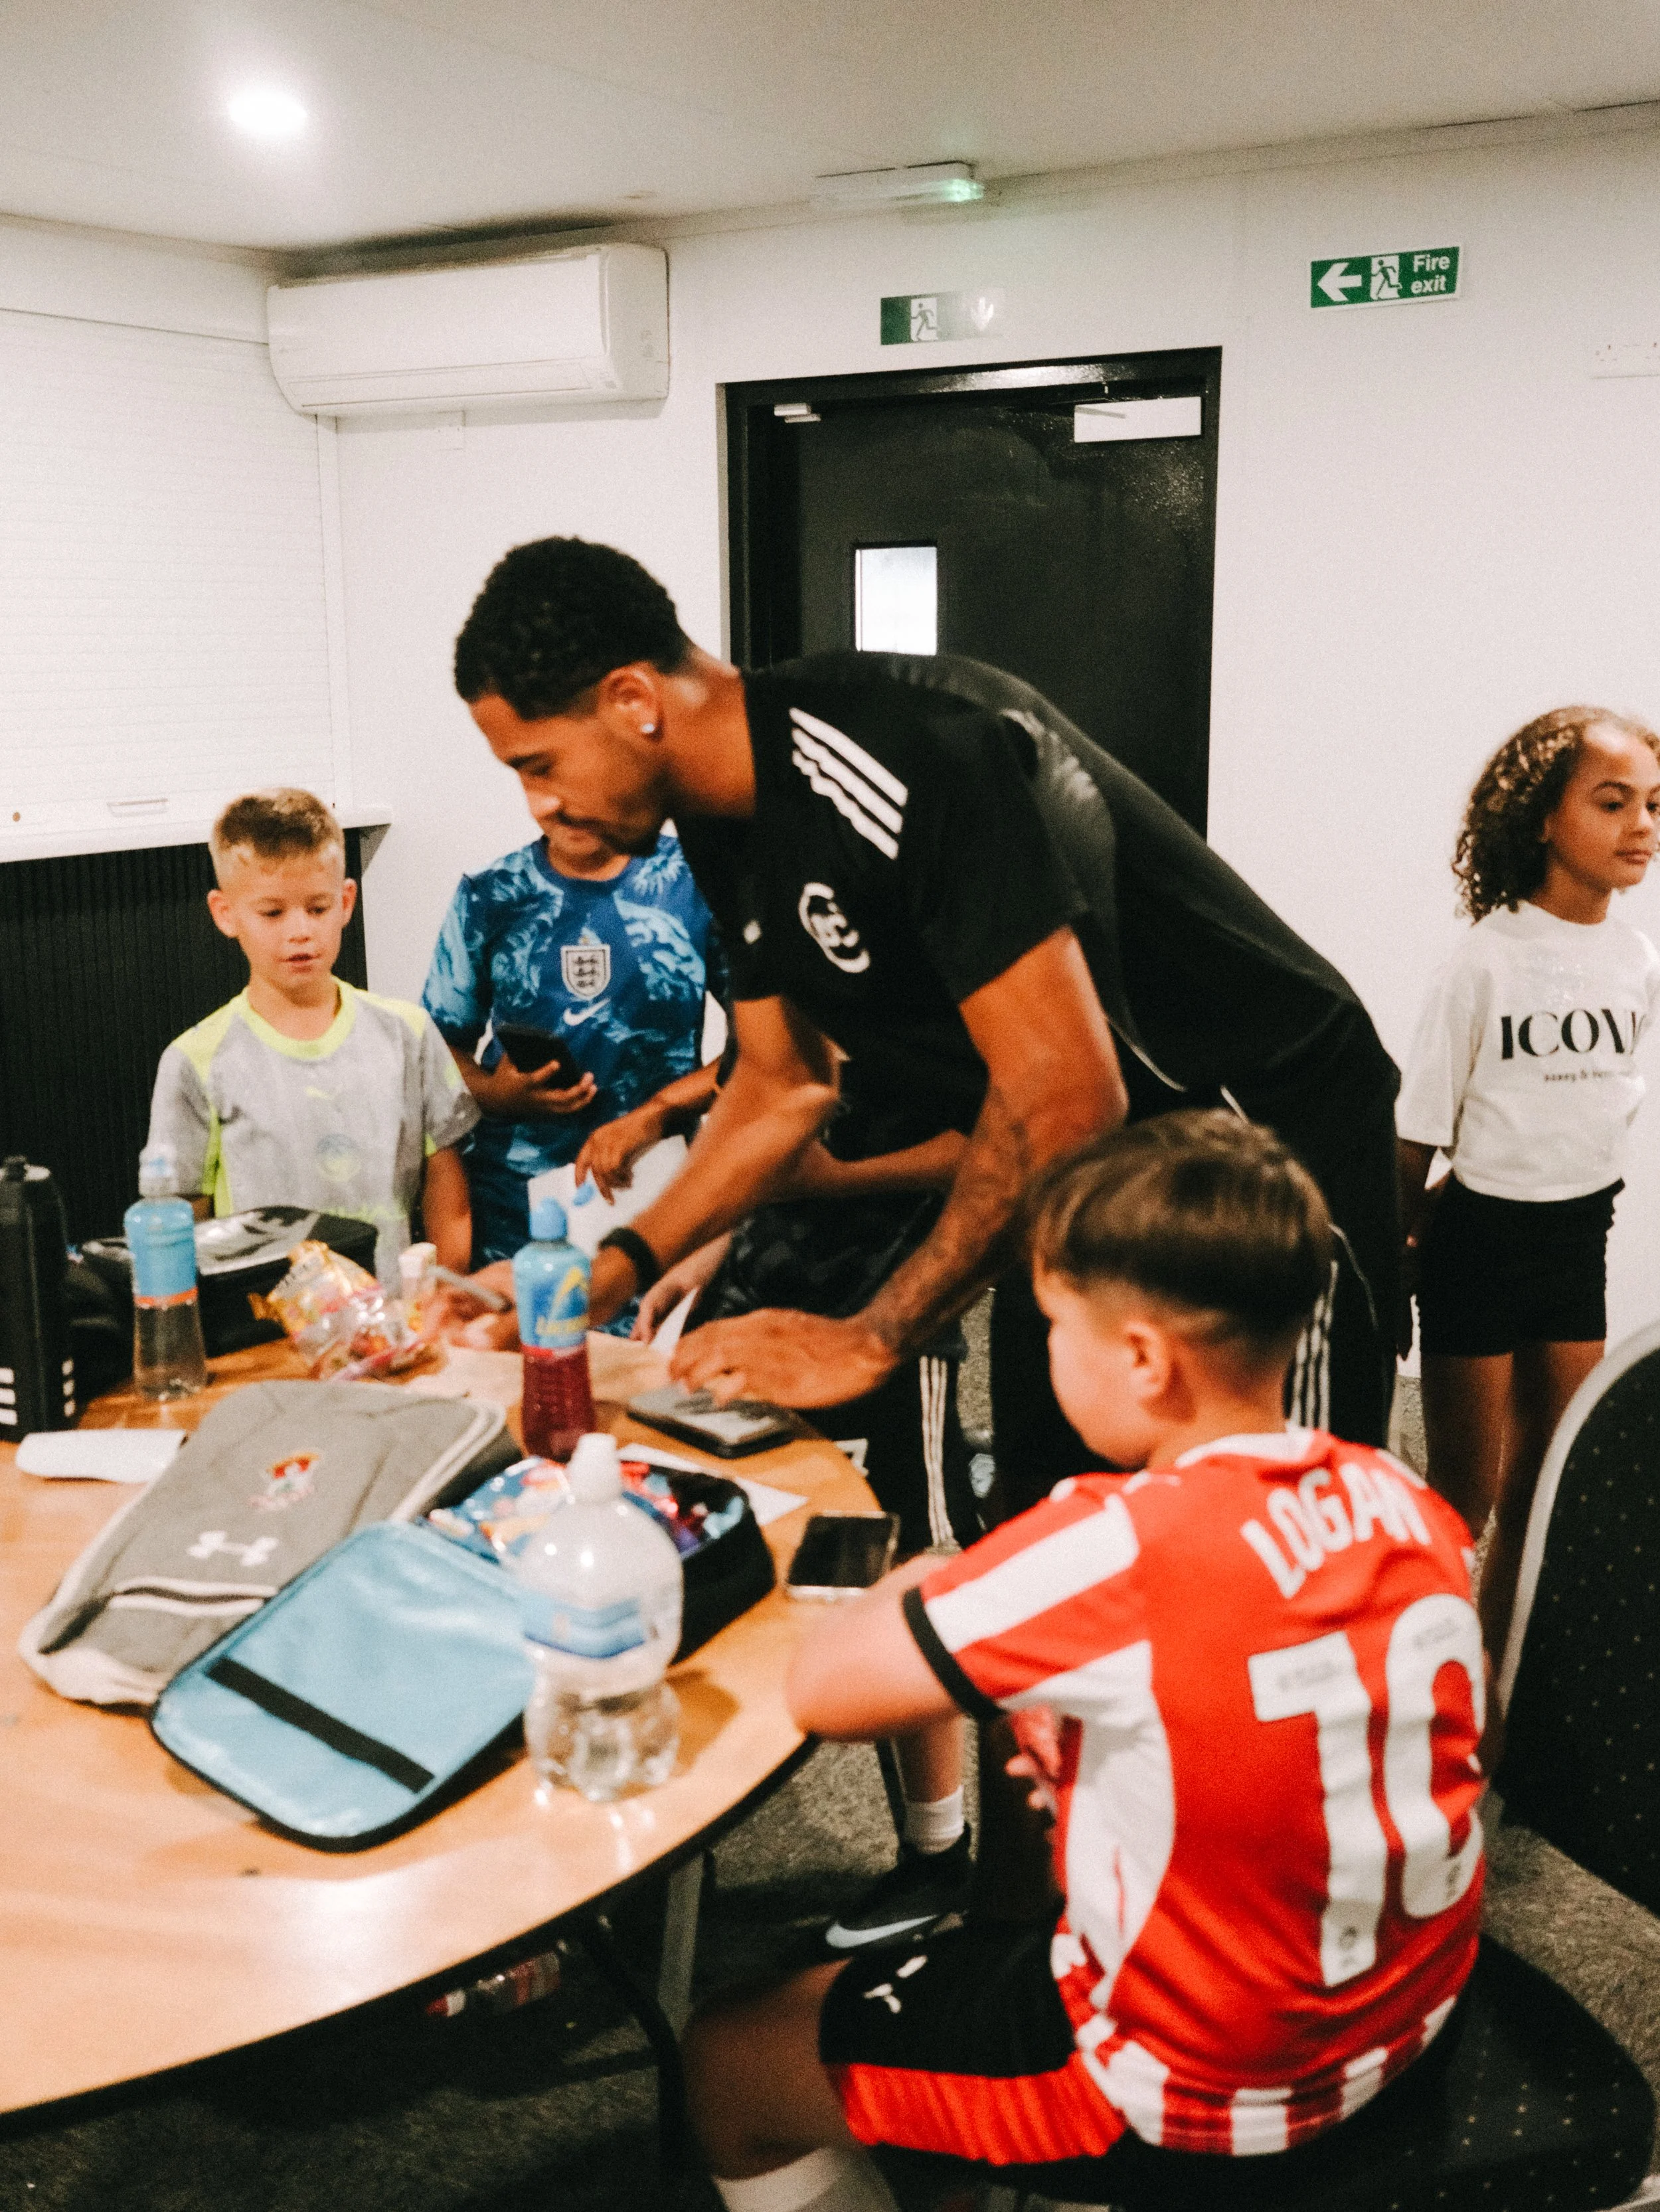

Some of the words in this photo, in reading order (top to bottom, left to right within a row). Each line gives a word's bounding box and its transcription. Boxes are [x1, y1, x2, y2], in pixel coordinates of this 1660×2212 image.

[1411, 275, 1446, 294] exit
[1414, 254, 1450, 273] Fire
[1240, 1462, 1432, 1600] LOGAN
[1248, 1592, 1487, 1988] 10
